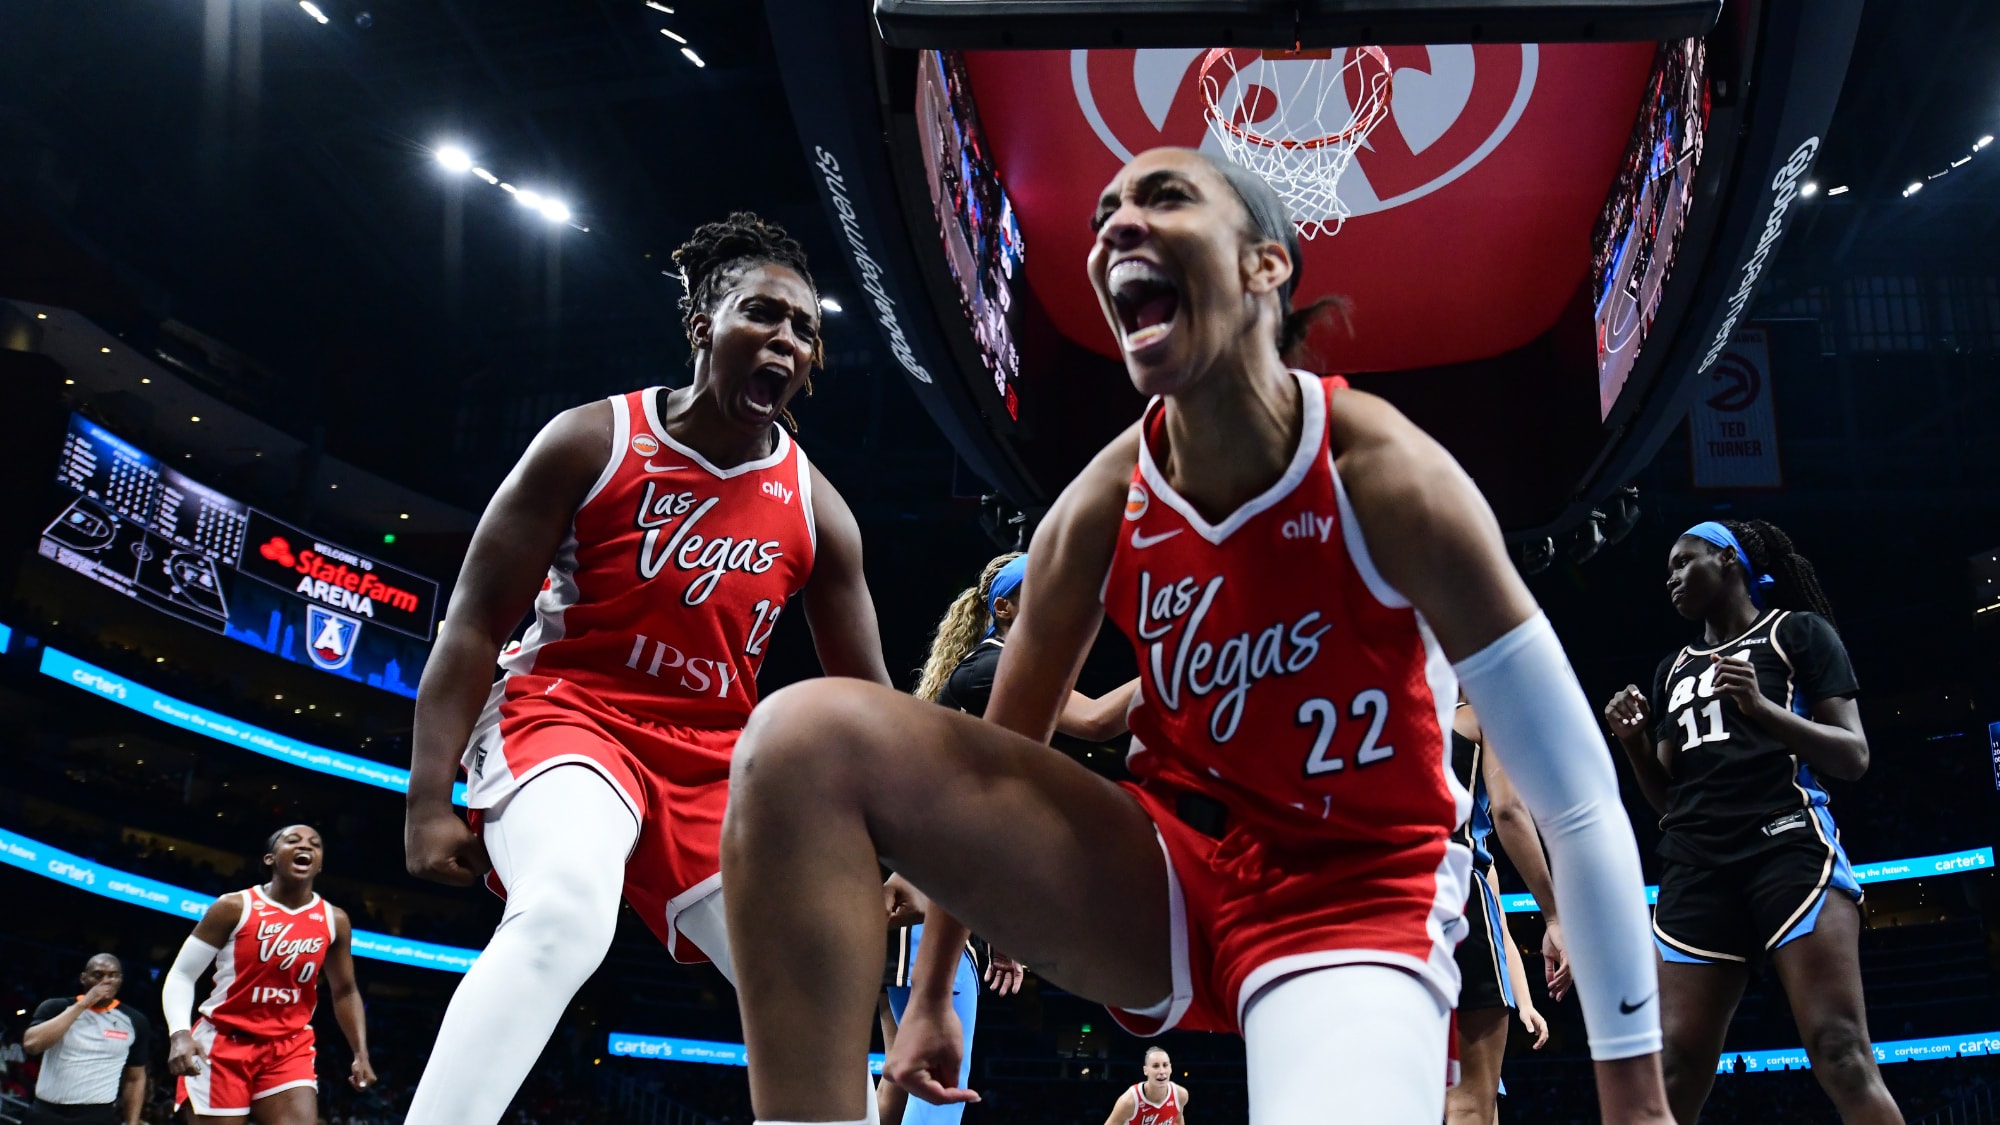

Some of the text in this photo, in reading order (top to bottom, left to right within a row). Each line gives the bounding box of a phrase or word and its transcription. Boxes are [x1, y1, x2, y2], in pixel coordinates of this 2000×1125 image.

[1720, 422, 1746, 438] TED
[1707, 441, 1763, 457] TURNER
[637, 481, 697, 527] Las
[762, 480, 793, 504] ally
[1282, 512, 1333, 543] ally
[314, 542, 373, 571] WELCOME TO
[639, 497, 783, 606] Vegas
[297, 576, 374, 617] ARENA
[1139, 571, 1199, 639] Las
[745, 599, 781, 655] 12
[625, 633, 738, 698] IPSY
[1151, 575, 1332, 743] Vegas
[72, 669, 127, 699] carter's
[1298, 688, 1395, 775] 22
[1677, 699, 1731, 752] 11
[1935, 853, 1985, 871] carter's
[48, 860, 95, 885] carter's
[108, 880, 170, 904] carters.com
[180, 899, 209, 916] cart
[1513, 899, 1537, 907] carte
[257, 920, 284, 941] Las
[259, 923, 323, 970] Vegas
[297, 961, 316, 984] 0
[251, 986, 302, 1005] IPSY
[615, 1040, 672, 1056] carter's
[681, 1047, 736, 1058] carters.com
[1895, 1044, 1951, 1055] carters.com
